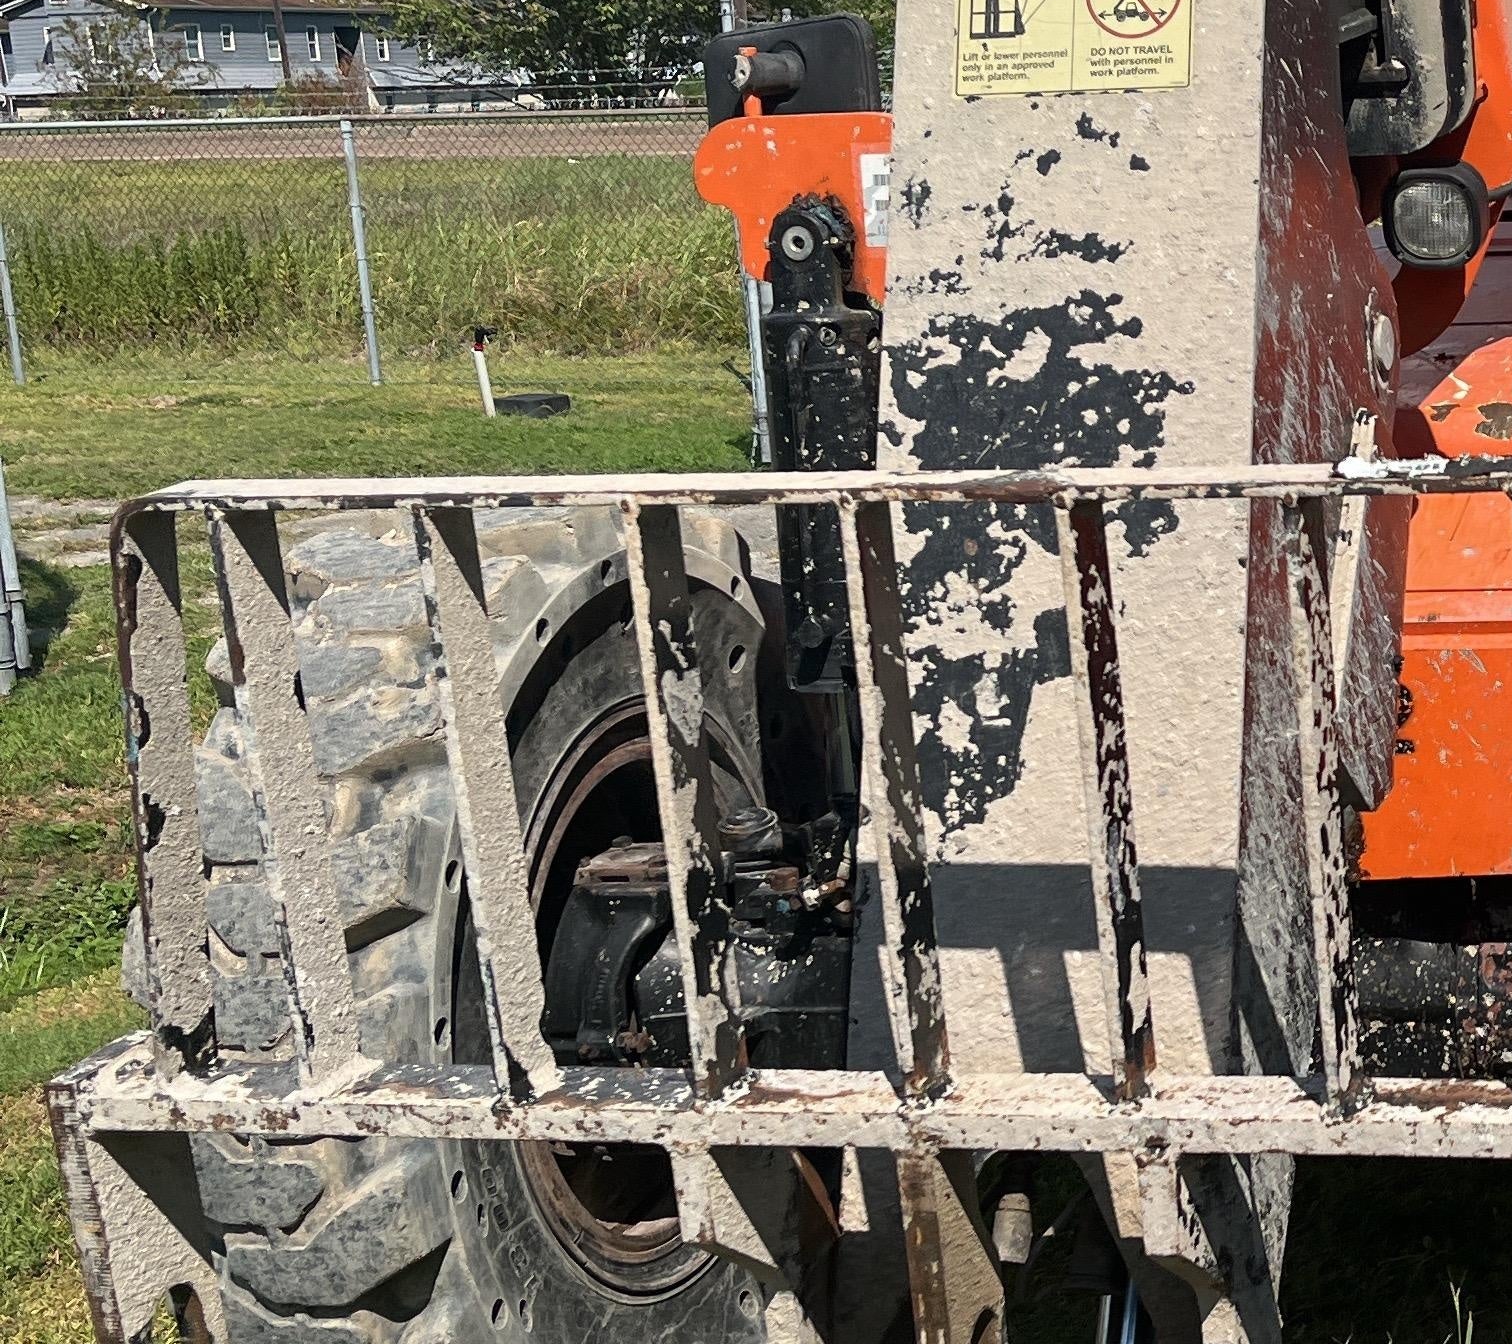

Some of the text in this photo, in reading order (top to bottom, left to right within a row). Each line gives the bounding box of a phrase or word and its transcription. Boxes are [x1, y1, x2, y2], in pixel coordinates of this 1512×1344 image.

[962, 52, 979, 62] Lift
[993, 51, 1020, 61] lower
[1022, 48, 1068, 61] personnel
[1090, 45, 1174, 57] DO NOT TRAVEL
[962, 60, 1055, 73] only in an approved
[1089, 55, 1174, 67] with personnel in
[961, 71, 1031, 83] work platform.
[1089, 66, 1160, 77] work platform.
